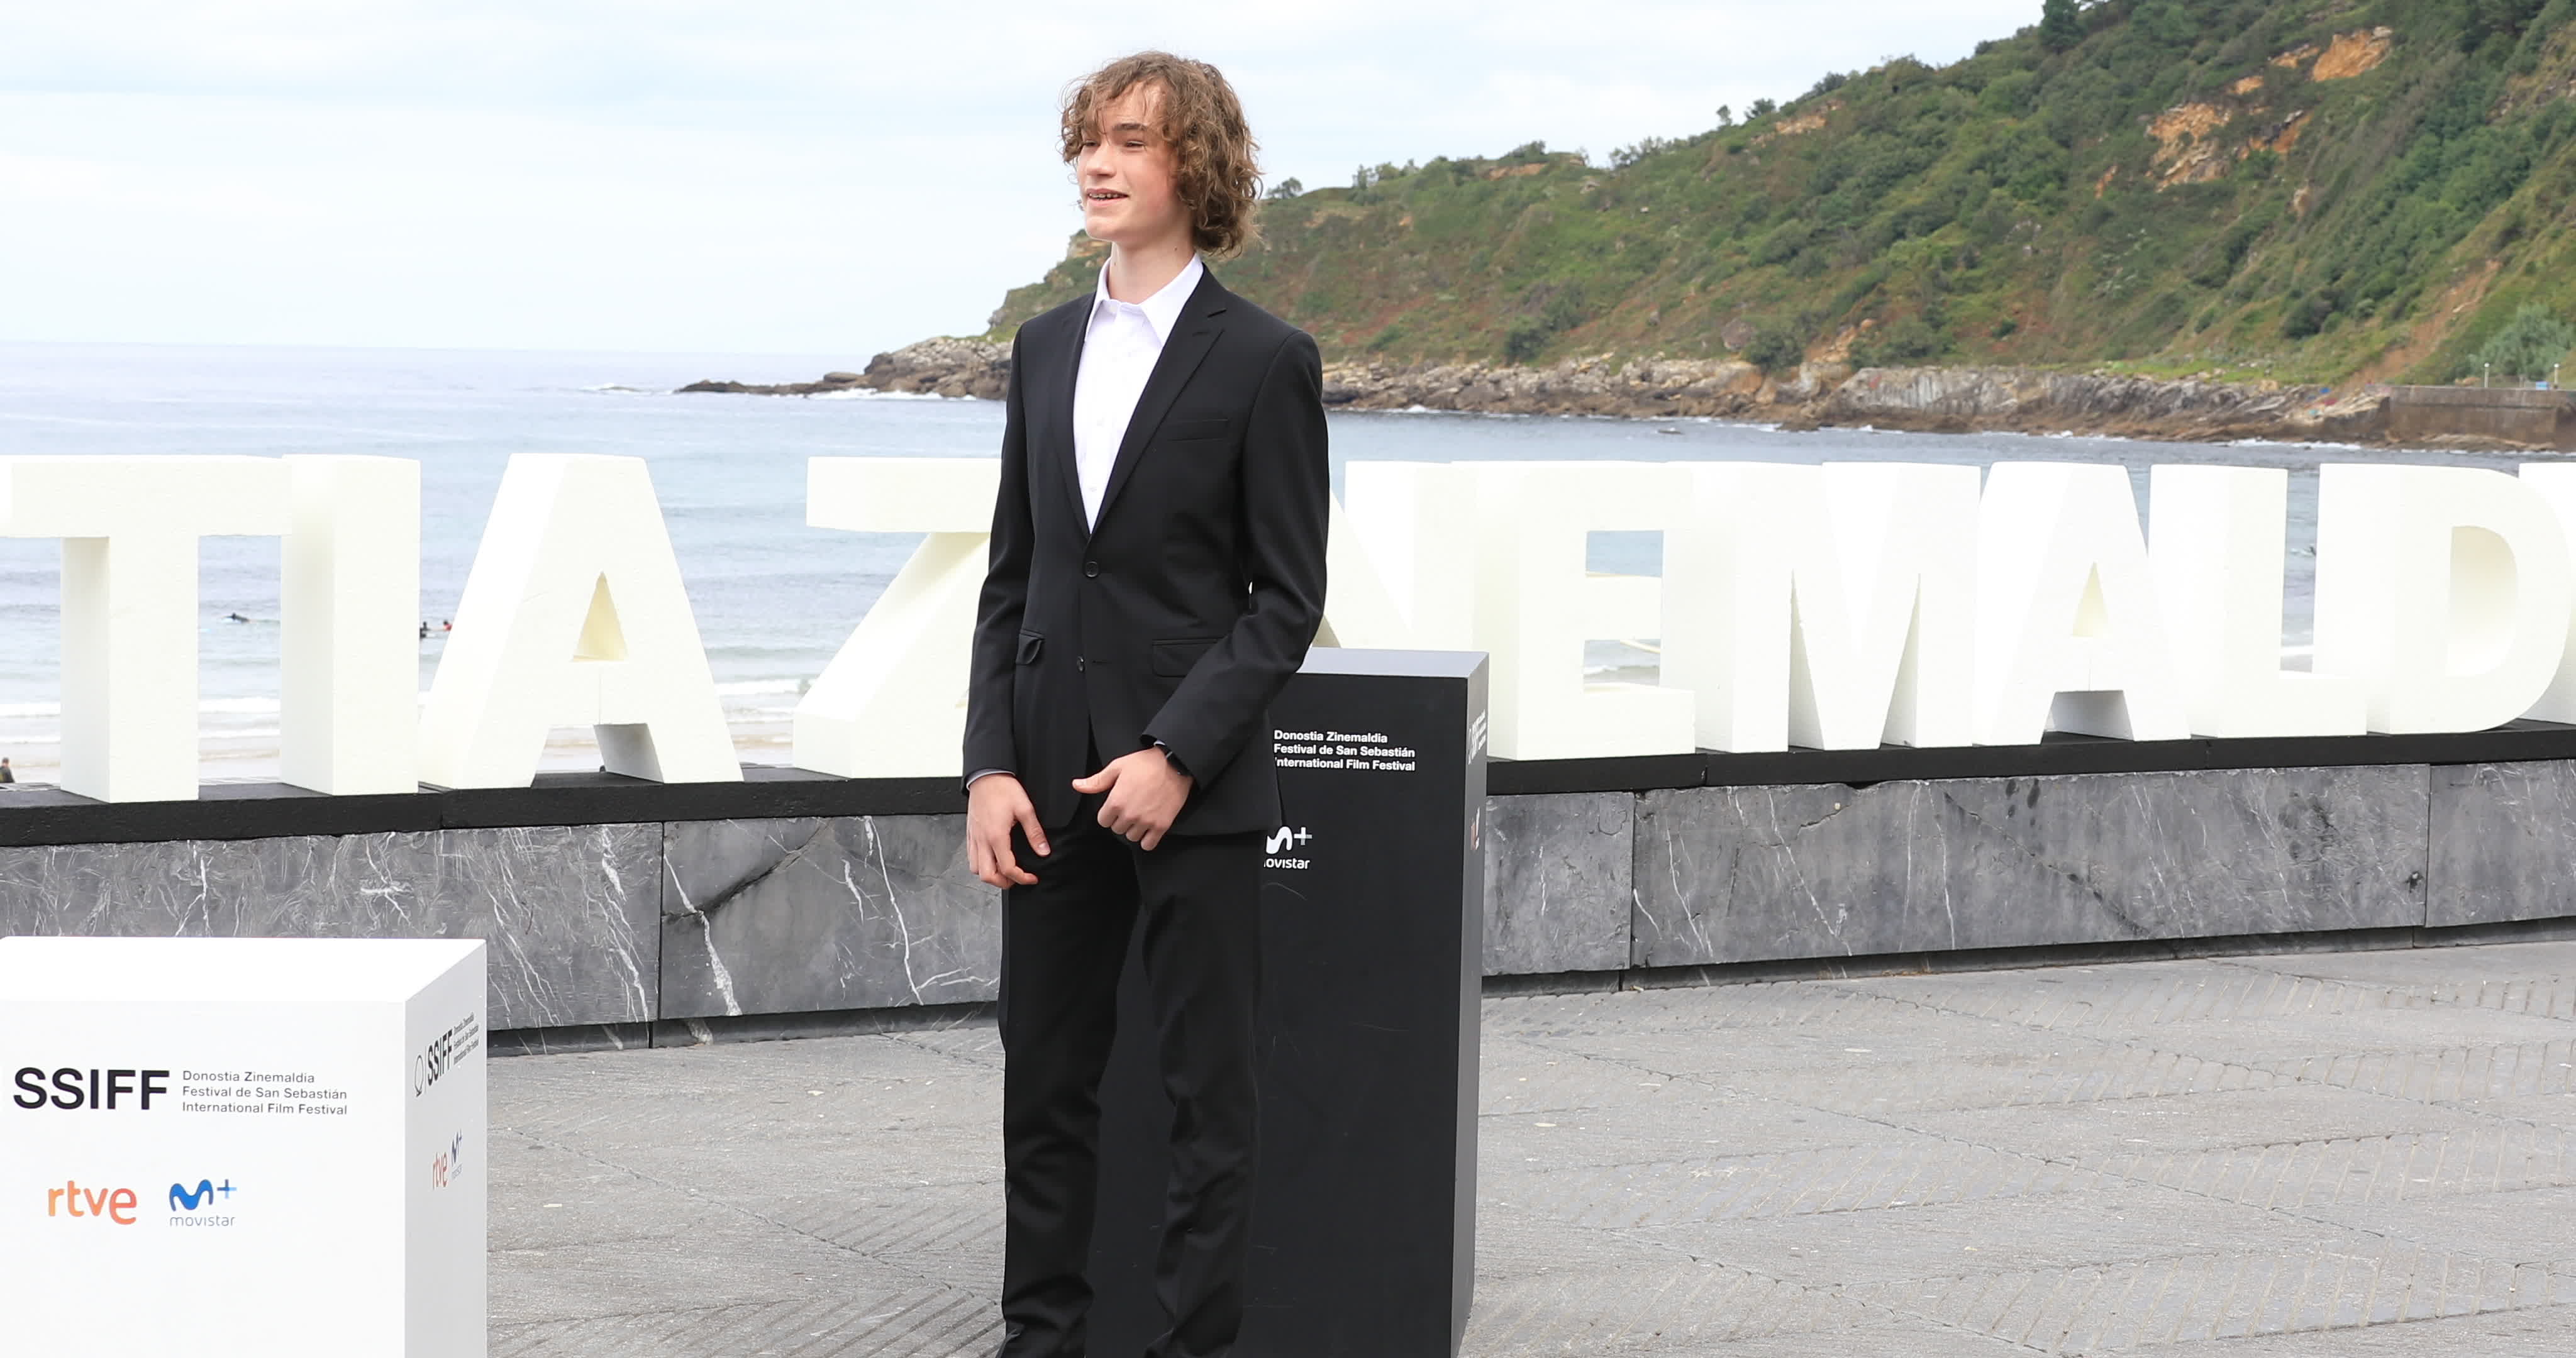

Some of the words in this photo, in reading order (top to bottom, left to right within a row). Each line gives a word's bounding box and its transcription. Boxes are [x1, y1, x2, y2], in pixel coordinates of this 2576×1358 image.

[1274, 730, 1324, 741] Donostia
[1326, 732, 1387, 743] Zinemaldia
[1274, 743, 1316, 754] Festival
[1319, 744, 1333, 755] de
[1336, 746, 1357, 756] San
[1360, 746, 1415, 758] Sebastián
[1275, 757, 1343, 768] nternational
[1346, 759, 1369, 770] Film
[1372, 760, 1415, 771] Festival
[1264, 858, 1310, 869] ovistar
[428, 1029, 452, 1086] SSIFF
[182, 1071, 240, 1082] Donostia
[244, 1071, 315, 1083] Zinemaldia
[13, 1067, 170, 1110] SSIFF
[182, 1086, 231, 1096] Festival
[236, 1087, 251, 1097] de
[256, 1088, 279, 1098] San
[284, 1088, 347, 1099] Sebastián
[182, 1101, 264, 1113] International
[268, 1103, 294, 1113] Film
[299, 1104, 347, 1115] Festival
[48, 1180, 137, 1225] rtve
[170, 1215, 236, 1227] movistar
